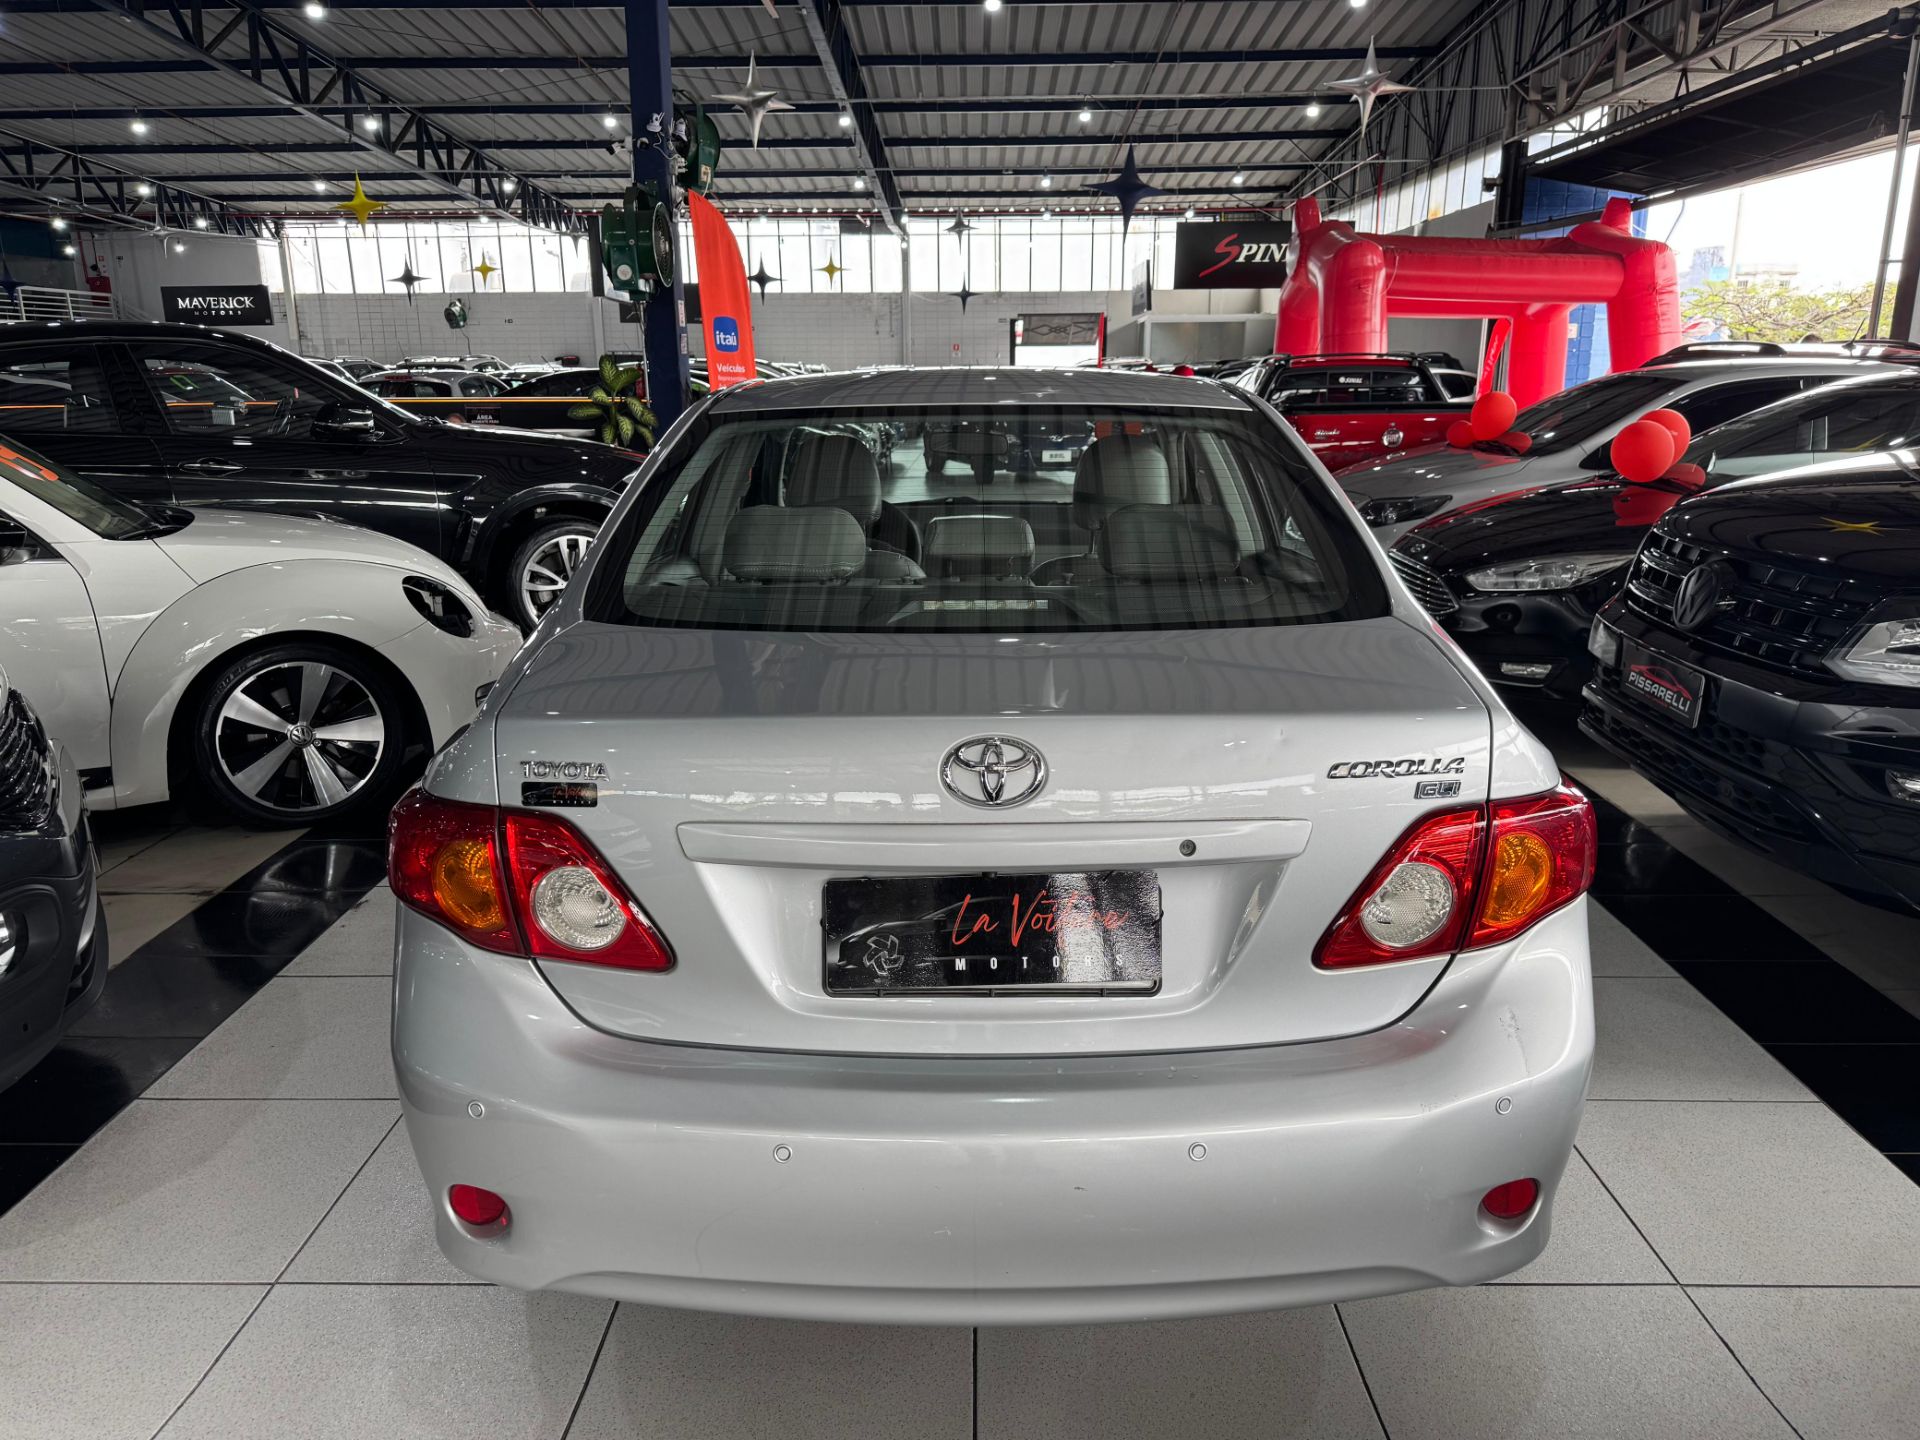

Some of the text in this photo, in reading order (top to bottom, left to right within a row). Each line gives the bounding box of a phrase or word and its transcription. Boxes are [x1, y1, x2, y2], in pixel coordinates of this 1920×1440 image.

[1199, 233, 1291, 278] SPIN
[177, 297, 255, 309] MAVERICK
[1628, 671, 1691, 713] PISSARELLI
[520, 761, 610, 782] TOYOTA
[1327, 757, 1465, 779] COROLLA
[951, 893, 999, 946] La
[954, 953, 1123, 971] MOTORS
